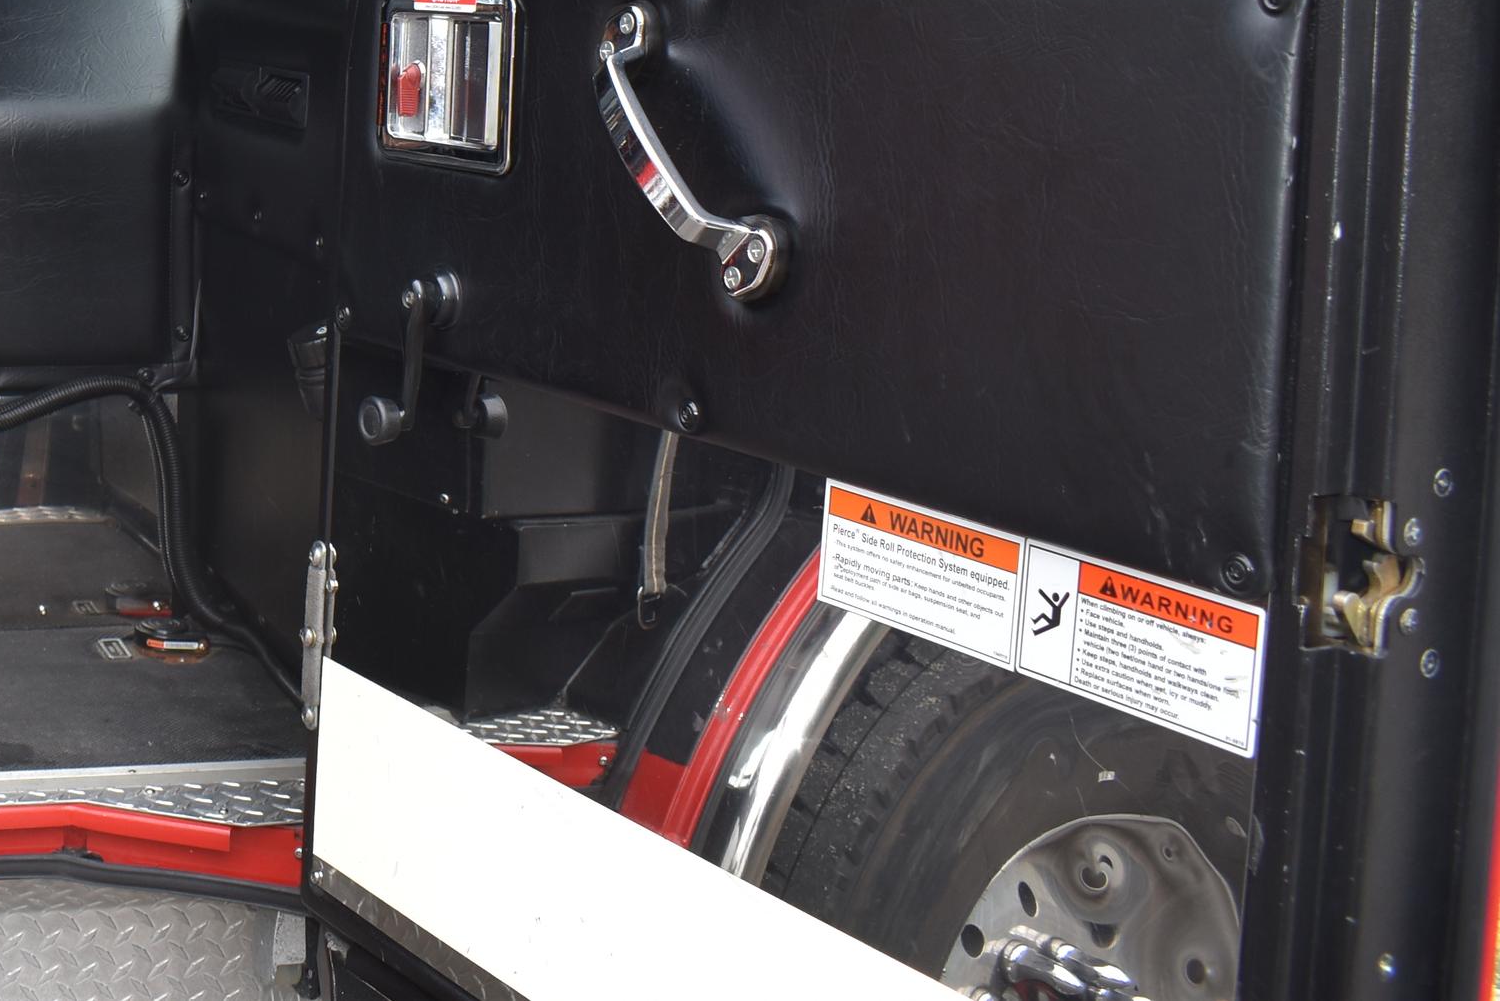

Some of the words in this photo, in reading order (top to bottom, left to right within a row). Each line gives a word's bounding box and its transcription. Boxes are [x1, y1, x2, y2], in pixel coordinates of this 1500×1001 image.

[888, 510, 984, 559] WARNING
[847, 544, 864, 555] system
[866, 549, 880, 559] offers
[889, 557, 904, 568] safety
[906, 563, 941, 579] enhancement
[951, 578, 975, 591] unbelted
[861, 532, 877, 546] Side
[879, 538, 894, 552] Roll
[896, 543, 936, 566] Protection
[938, 557, 968, 578] System
[969, 568, 1010, 592] equipped.
[844, 589, 853, 598] and
[854, 592, 869, 603] follow
[878, 601, 901, 615] warnings
[908, 612, 933, 627] operation
[863, 562, 890, 581] moving
[914, 582, 927, 592] Keep
[928, 587, 944, 597] hands
[946, 593, 956, 601] and
[957, 597, 972, 607] other
[972, 602, 993, 615] objects
[994, 610, 1004, 618] out
[869, 576, 880, 585] path
[888, 582, 899, 591] side
[923, 595, 954, 611] suspension
[970, 611, 980, 619] and
[1081, 596, 1098, 608] When
[1099, 603, 1125, 618] climbing
[1145, 618, 1154, 626] off
[1119, 583, 1234, 635] WARNING
[1084, 618, 1096, 628] Use
[1098, 623, 1114, 635] steps
[1116, 629, 1127, 638] and
[1129, 633, 1164, 651] handholds.
[1085, 608, 1100, 619] Face
[1101, 614, 1125, 627] vehicle.
[1082, 648, 1097, 660] Keep
[1099, 655, 1117, 667] steps,
[1118, 660, 1151, 678] handholds
[1153, 673, 1165, 683] and
[1166, 678, 1198, 696] walkways
[1199, 689, 1219, 702] clean.
[1083, 638, 1104, 651] vehicle
[1105, 646, 1119, 657] (two
[1120, 651, 1145, 665] feet/one
[1147, 660, 1163, 671] hand
[1173, 669, 1185, 679] two
[1186, 674, 1221, 691] hands/one
[1084, 628, 1109, 642] Maintain
[1110, 637, 1126, 648] three
[1128, 643, 1136, 653] (3)
[1137, 646, 1157, 659] points
[1159, 653, 1166, 662] of
[1167, 656, 1191, 670] contact
[1193, 665, 1206, 675] with
[1074, 675, 1091, 688] Death
[1101, 685, 1123, 699] serious
[1125, 694, 1142, 707] injury
[1144, 701, 1158, 713] may
[1159, 707, 1179, 719] occur.
[1080, 667, 1104, 683] Replace
[1106, 677, 1132, 692] surfaces
[1134, 687, 1151, 698] when
[1152, 694, 1170, 705] worn.
[1081, 658, 1093, 668] Use
[1094, 663, 1109, 673] extra
[1111, 668, 1134, 682] caution
[1135, 677, 1152, 688] when
[1168, 688, 1178, 700] icy
[1188, 696, 1212, 711] muddy.
